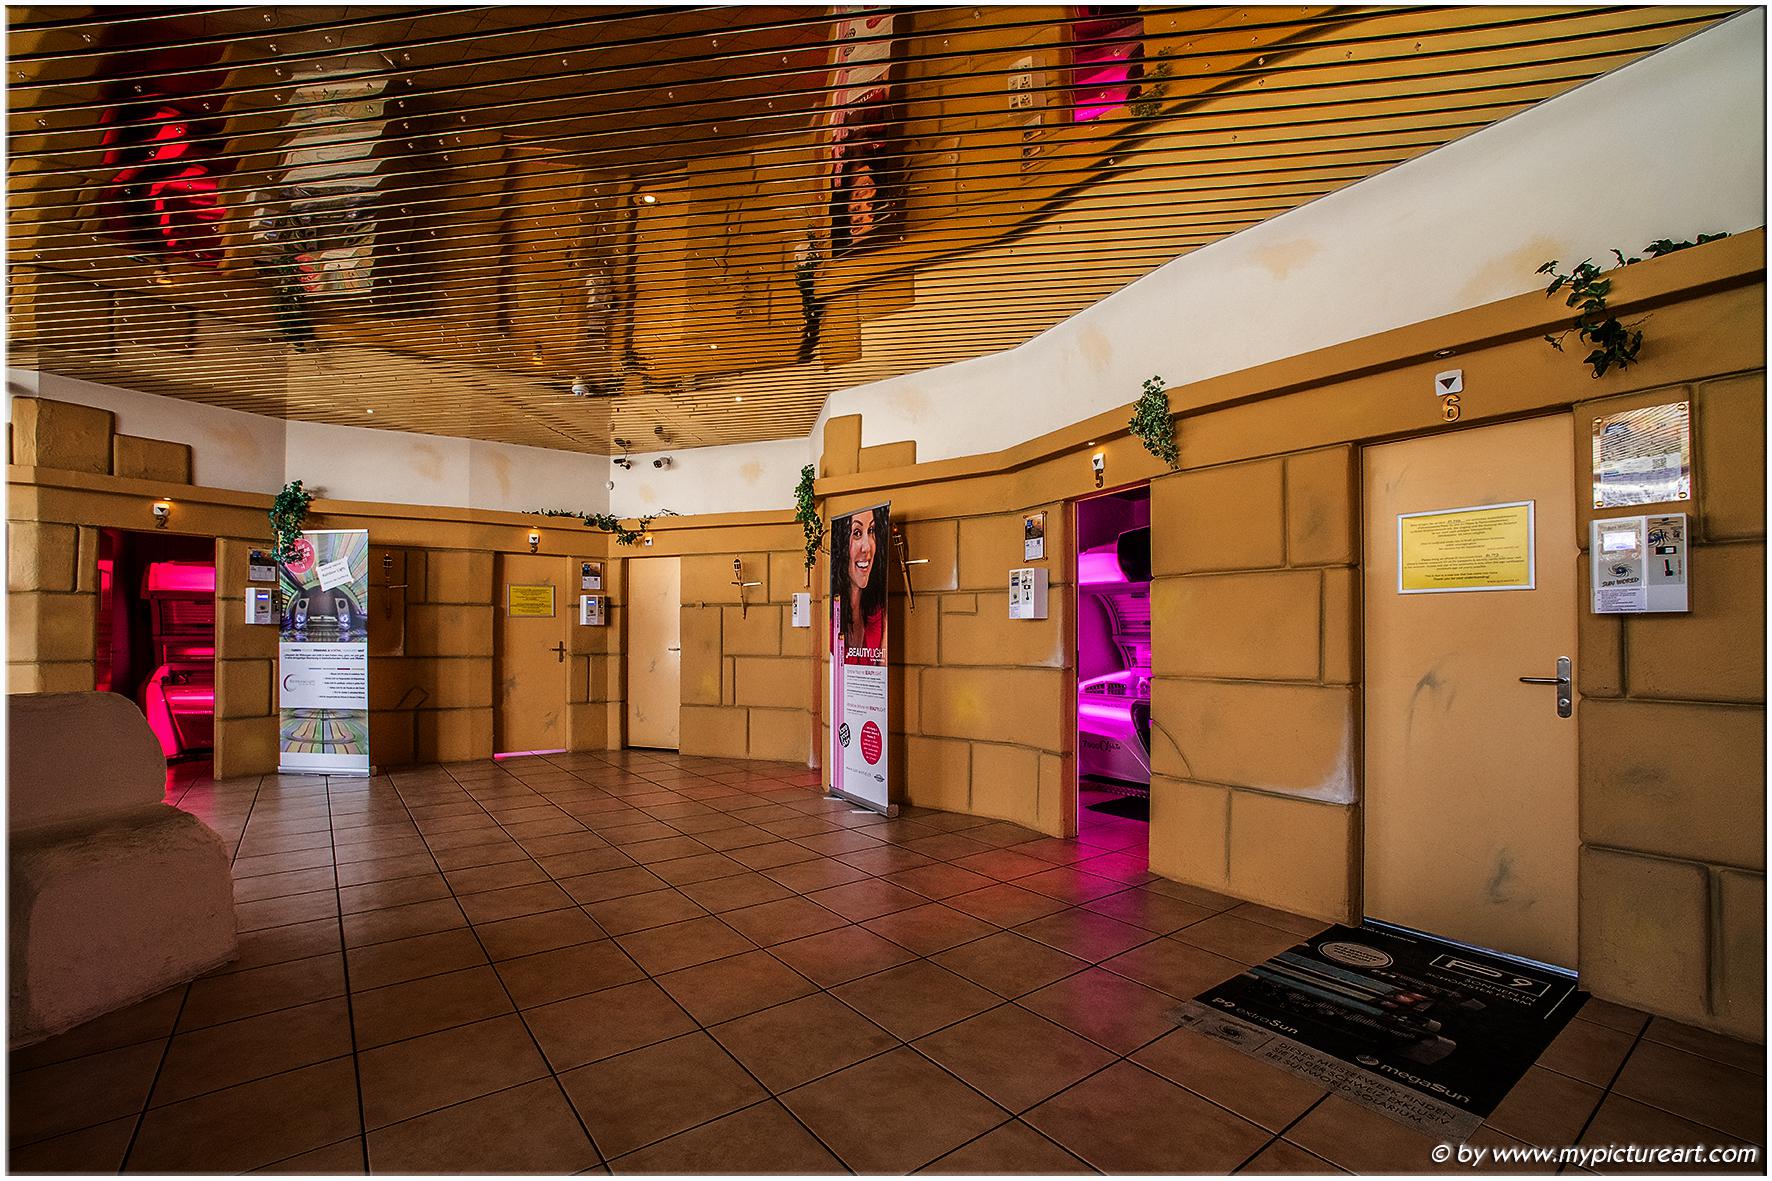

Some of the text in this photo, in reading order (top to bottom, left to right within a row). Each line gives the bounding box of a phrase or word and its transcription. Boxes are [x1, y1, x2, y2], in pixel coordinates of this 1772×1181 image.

[1441, 395, 1461, 422] 6
[1095, 470, 1104, 489] 5
[155, 515, 168, 529] 2
[1602, 577, 1640, 588] SUN WORLD
[848, 647, 887, 659] BEAUTYLIGHT
[1236, 1007, 1299, 1035] extraSun
[1264, 1051, 1424, 1124] BEI SUNWORLD SOLARIUM
[1279, 1042, 1456, 1120] DIESES MEISTERWERK FINDEN
[1304, 1060, 1328, 1075] DER
[1328, 1070, 1385, 1097] SCHWEIZ
[1386, 1096, 1450, 1126] EXKLUSIV
[1379, 1063, 1471, 1104] megaSun
